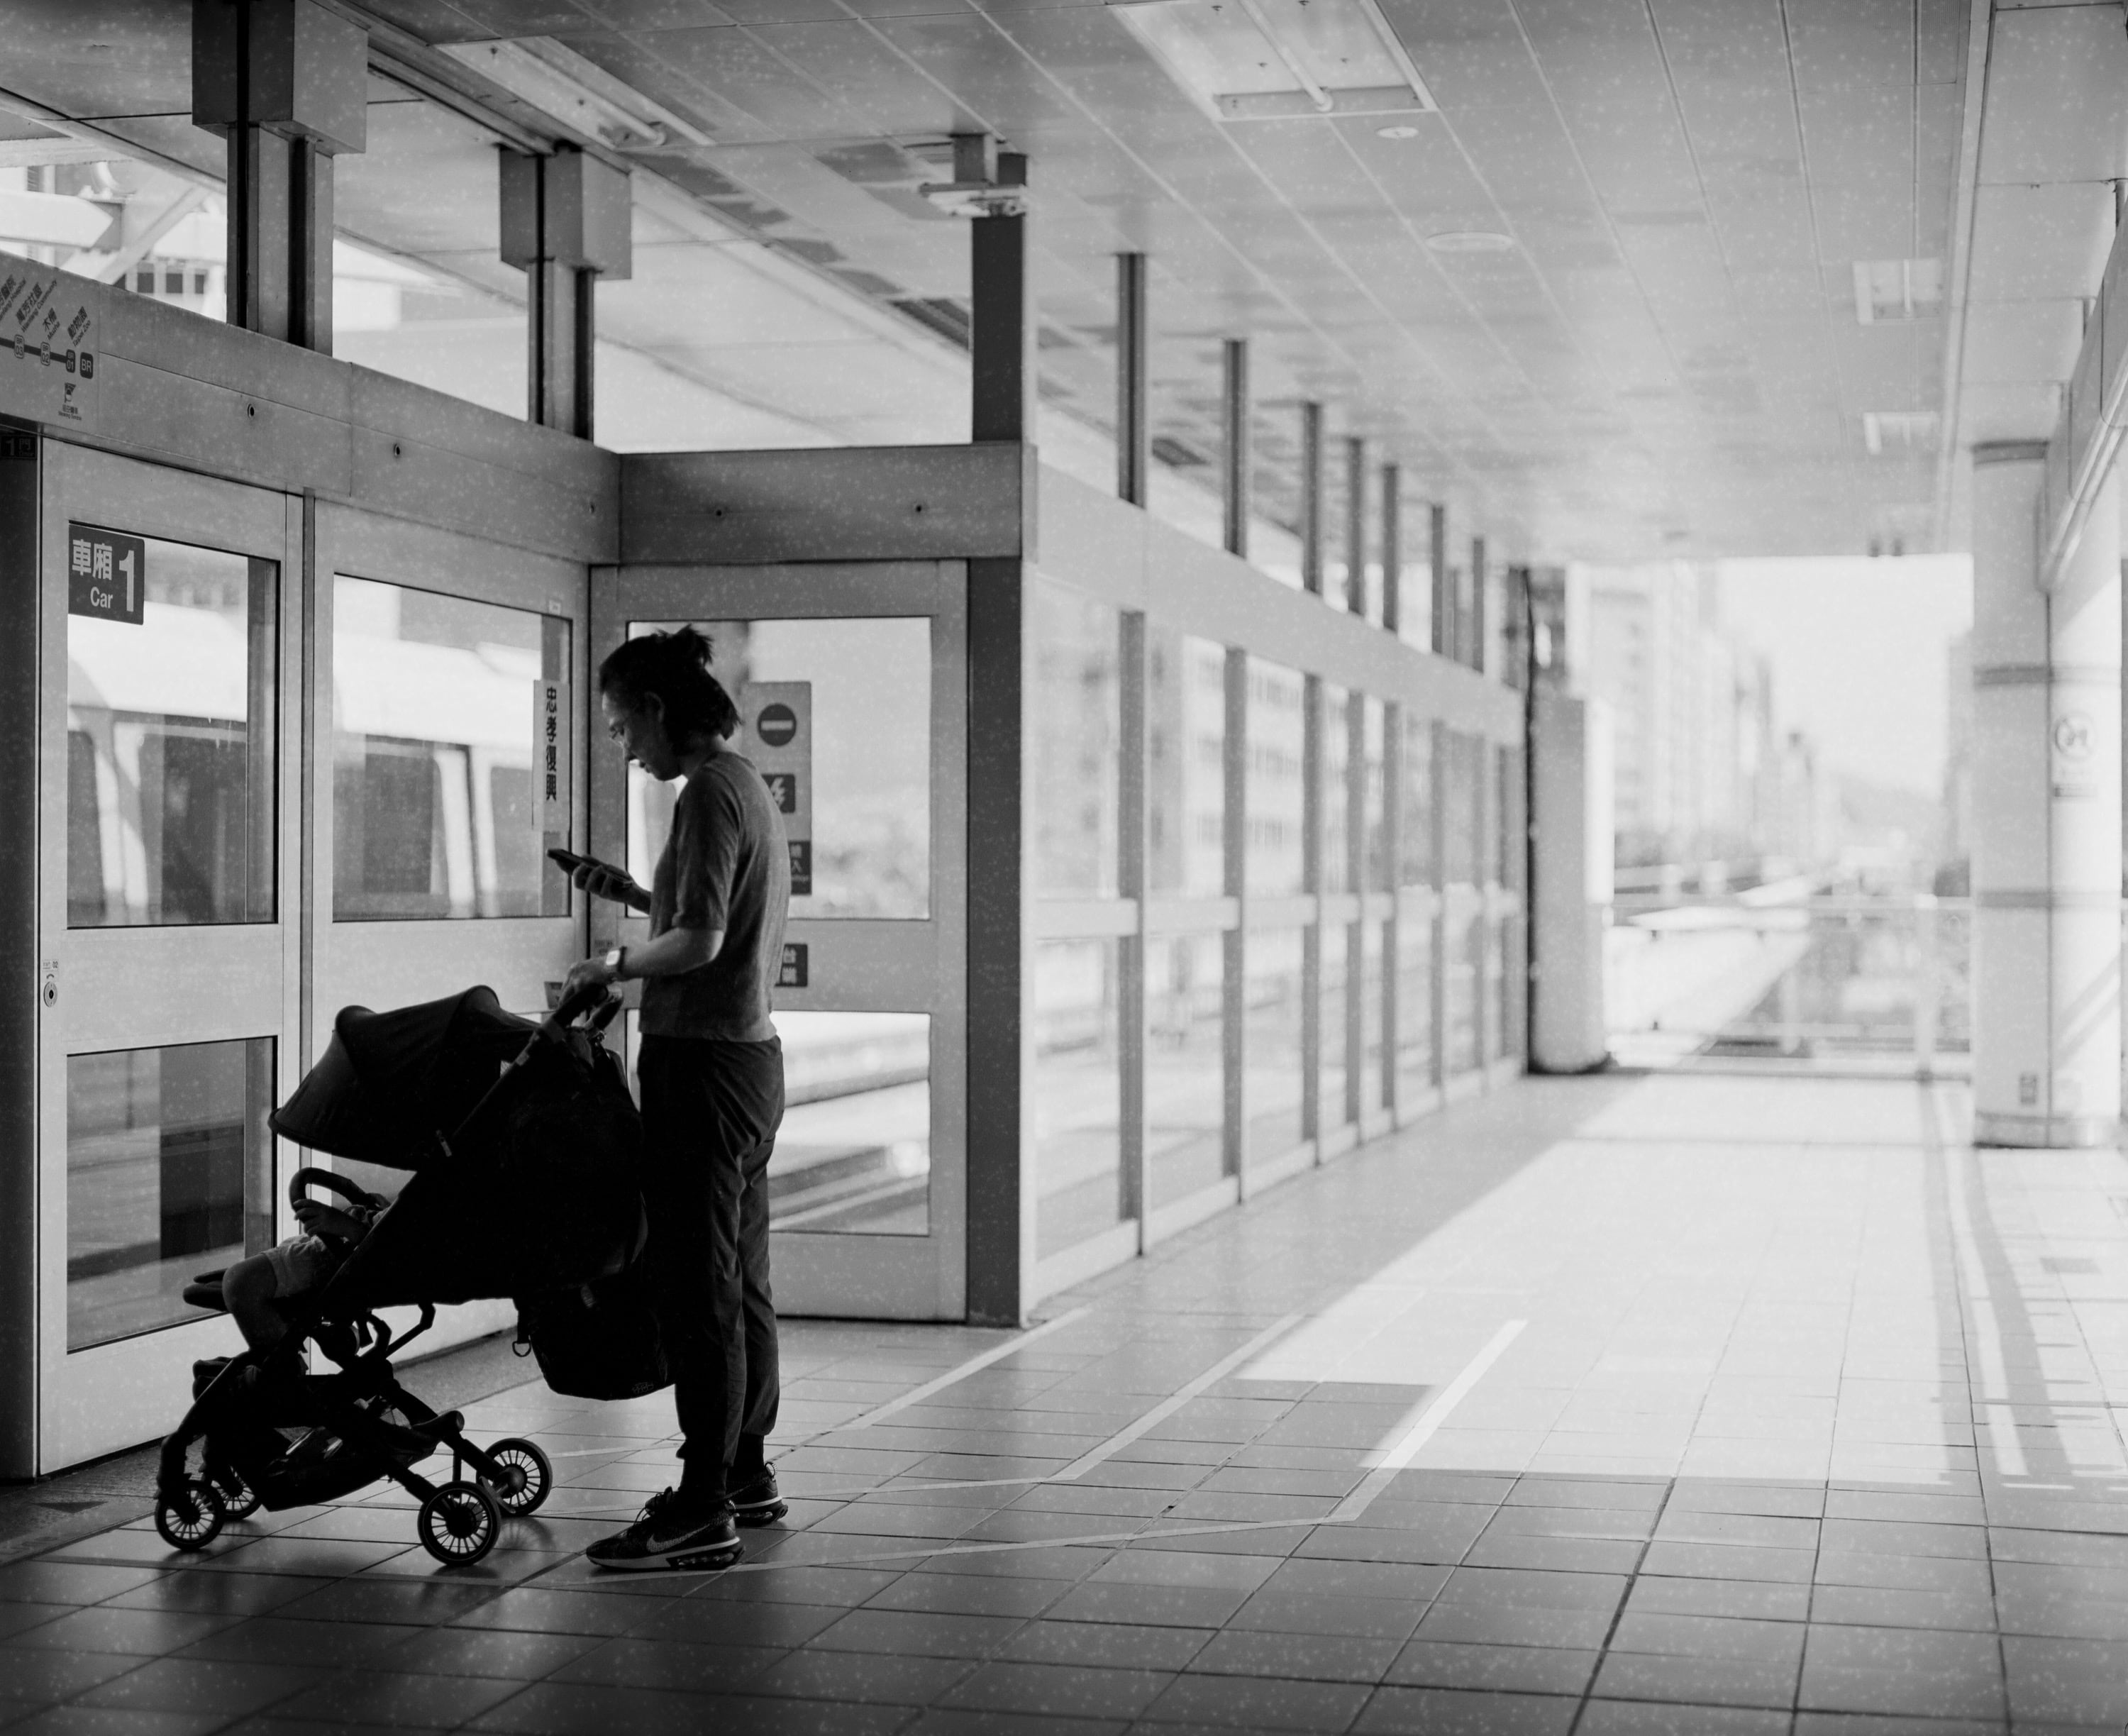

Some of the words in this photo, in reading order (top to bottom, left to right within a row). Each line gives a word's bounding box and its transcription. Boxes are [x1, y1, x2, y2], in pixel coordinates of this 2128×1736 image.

[37, 280, 57, 309] Community
[47, 321, 60, 341] Muzha
[67, 306, 88, 340] 動物園
[73, 330, 84, 347] Taipei
[82, 320, 91, 333] Zoo
[15, 345, 23, 355] 03
[42, 353, 50, 363] 02
[67, 360, 74, 370] 01
[82, 358, 92, 372] BR
[72, 538, 112, 580] 車廂
[119, 550, 135, 612] 1
[90, 586, 113, 609] Car
[545, 686, 557, 801] 忠孝復興
